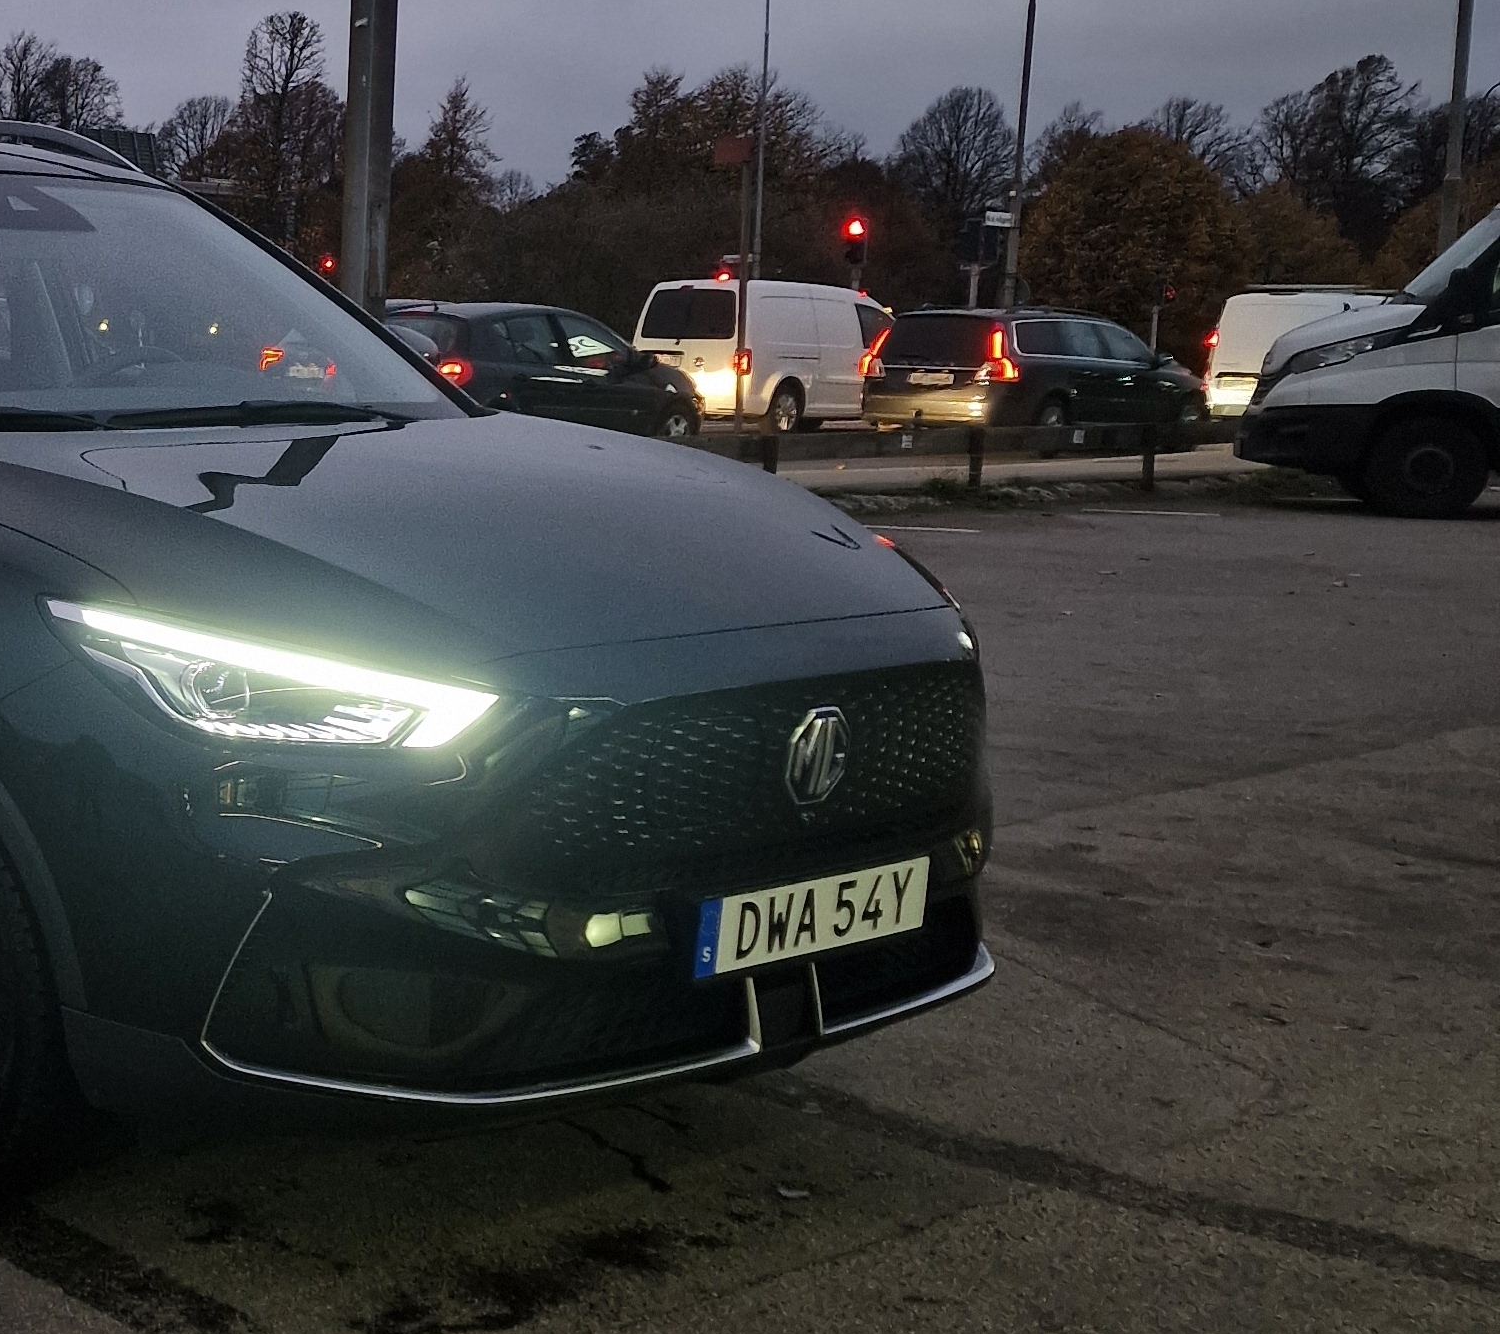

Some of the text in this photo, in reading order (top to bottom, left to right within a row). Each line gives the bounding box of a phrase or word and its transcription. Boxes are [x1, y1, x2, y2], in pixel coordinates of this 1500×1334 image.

[792, 715, 847, 796] MG
[703, 947, 711, 962] S
[735, 868, 914, 960] DWA 54Y
